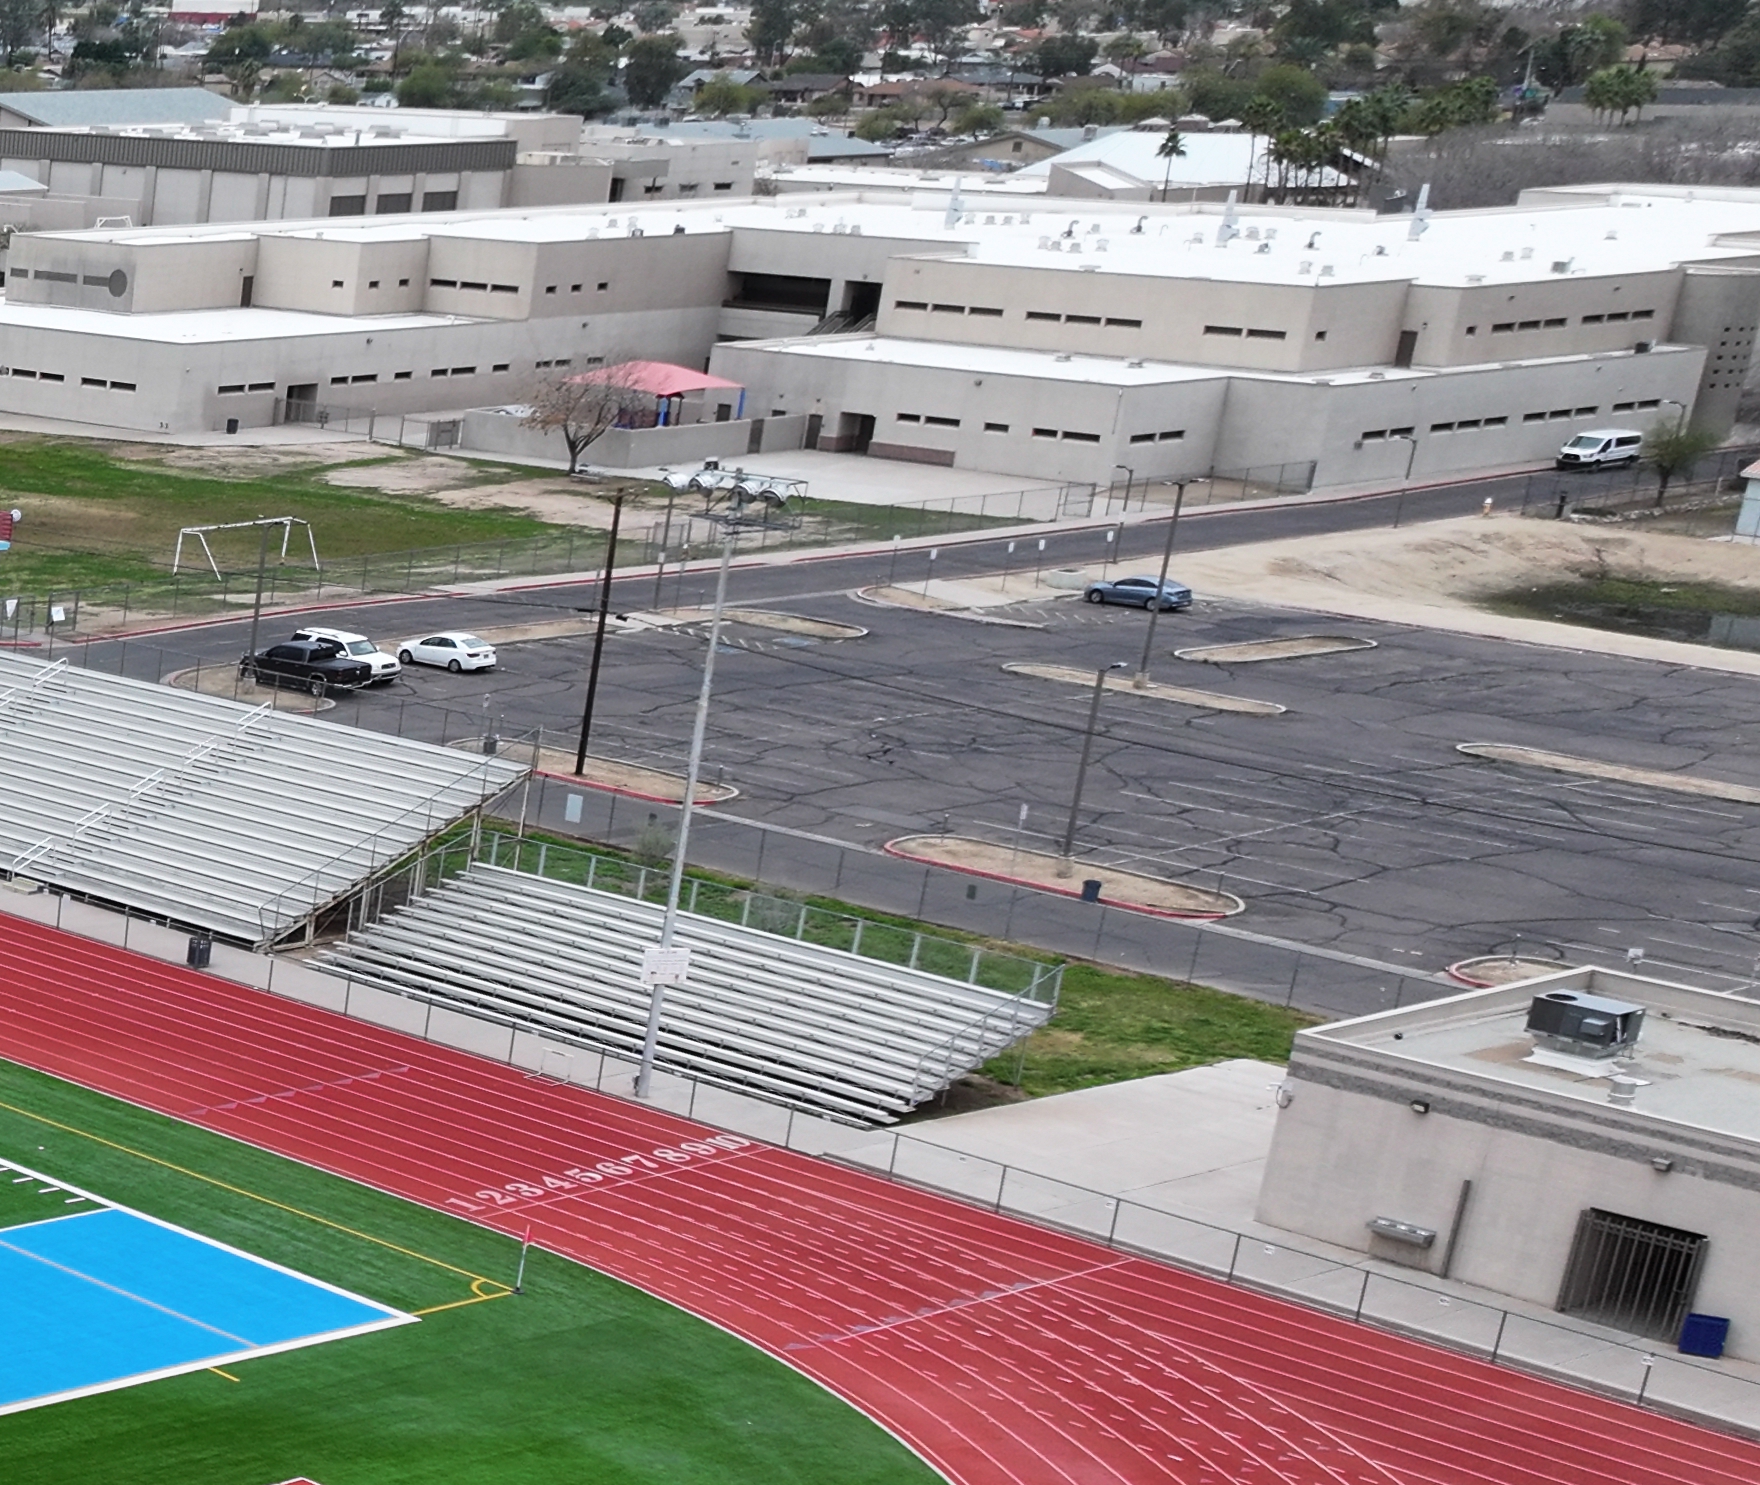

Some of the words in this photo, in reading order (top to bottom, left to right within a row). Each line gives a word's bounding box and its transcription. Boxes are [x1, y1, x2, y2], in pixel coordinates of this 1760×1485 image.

[448, 1197, 486, 1212] 1
[476, 1190, 516, 1205] 2
[505, 1183, 544, 1197] 3
[542, 1175, 578, 1190] 4
[564, 1168, 603, 1183] 5
[596, 1162, 633, 1176] 6
[620, 1154, 659, 1169] 7
[653, 1149, 691, 1163] 8
[681, 1142, 717, 1155] 9
[705, 1134, 751, 1150] 10
